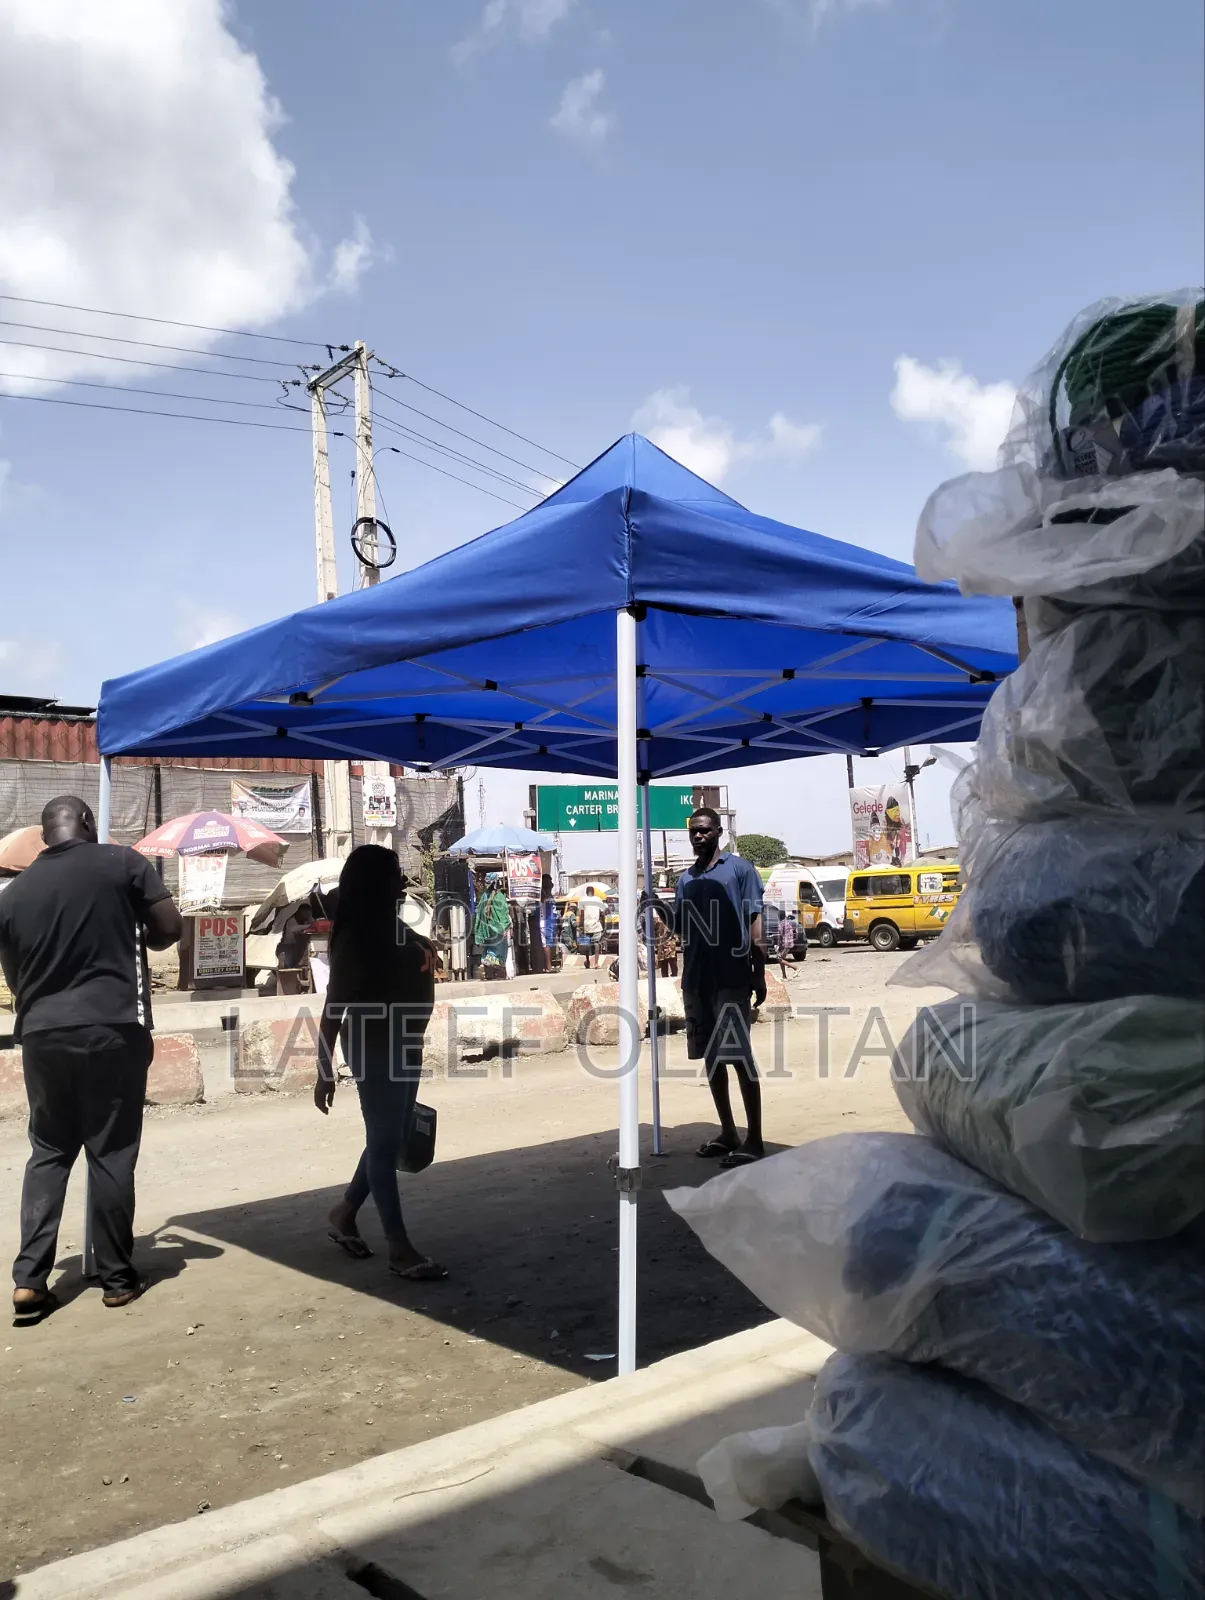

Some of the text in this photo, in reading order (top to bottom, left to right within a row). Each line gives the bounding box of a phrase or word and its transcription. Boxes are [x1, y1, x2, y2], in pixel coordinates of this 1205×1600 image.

[584, 790, 620, 801] MARINA
[566, 803, 640, 815] CARTER BRE
[183, 841, 238, 854] NORMAL SETTING
[508, 858, 528, 877] POS
[913, 894, 955, 905] TYRES
[200, 916, 238, 937] POS
